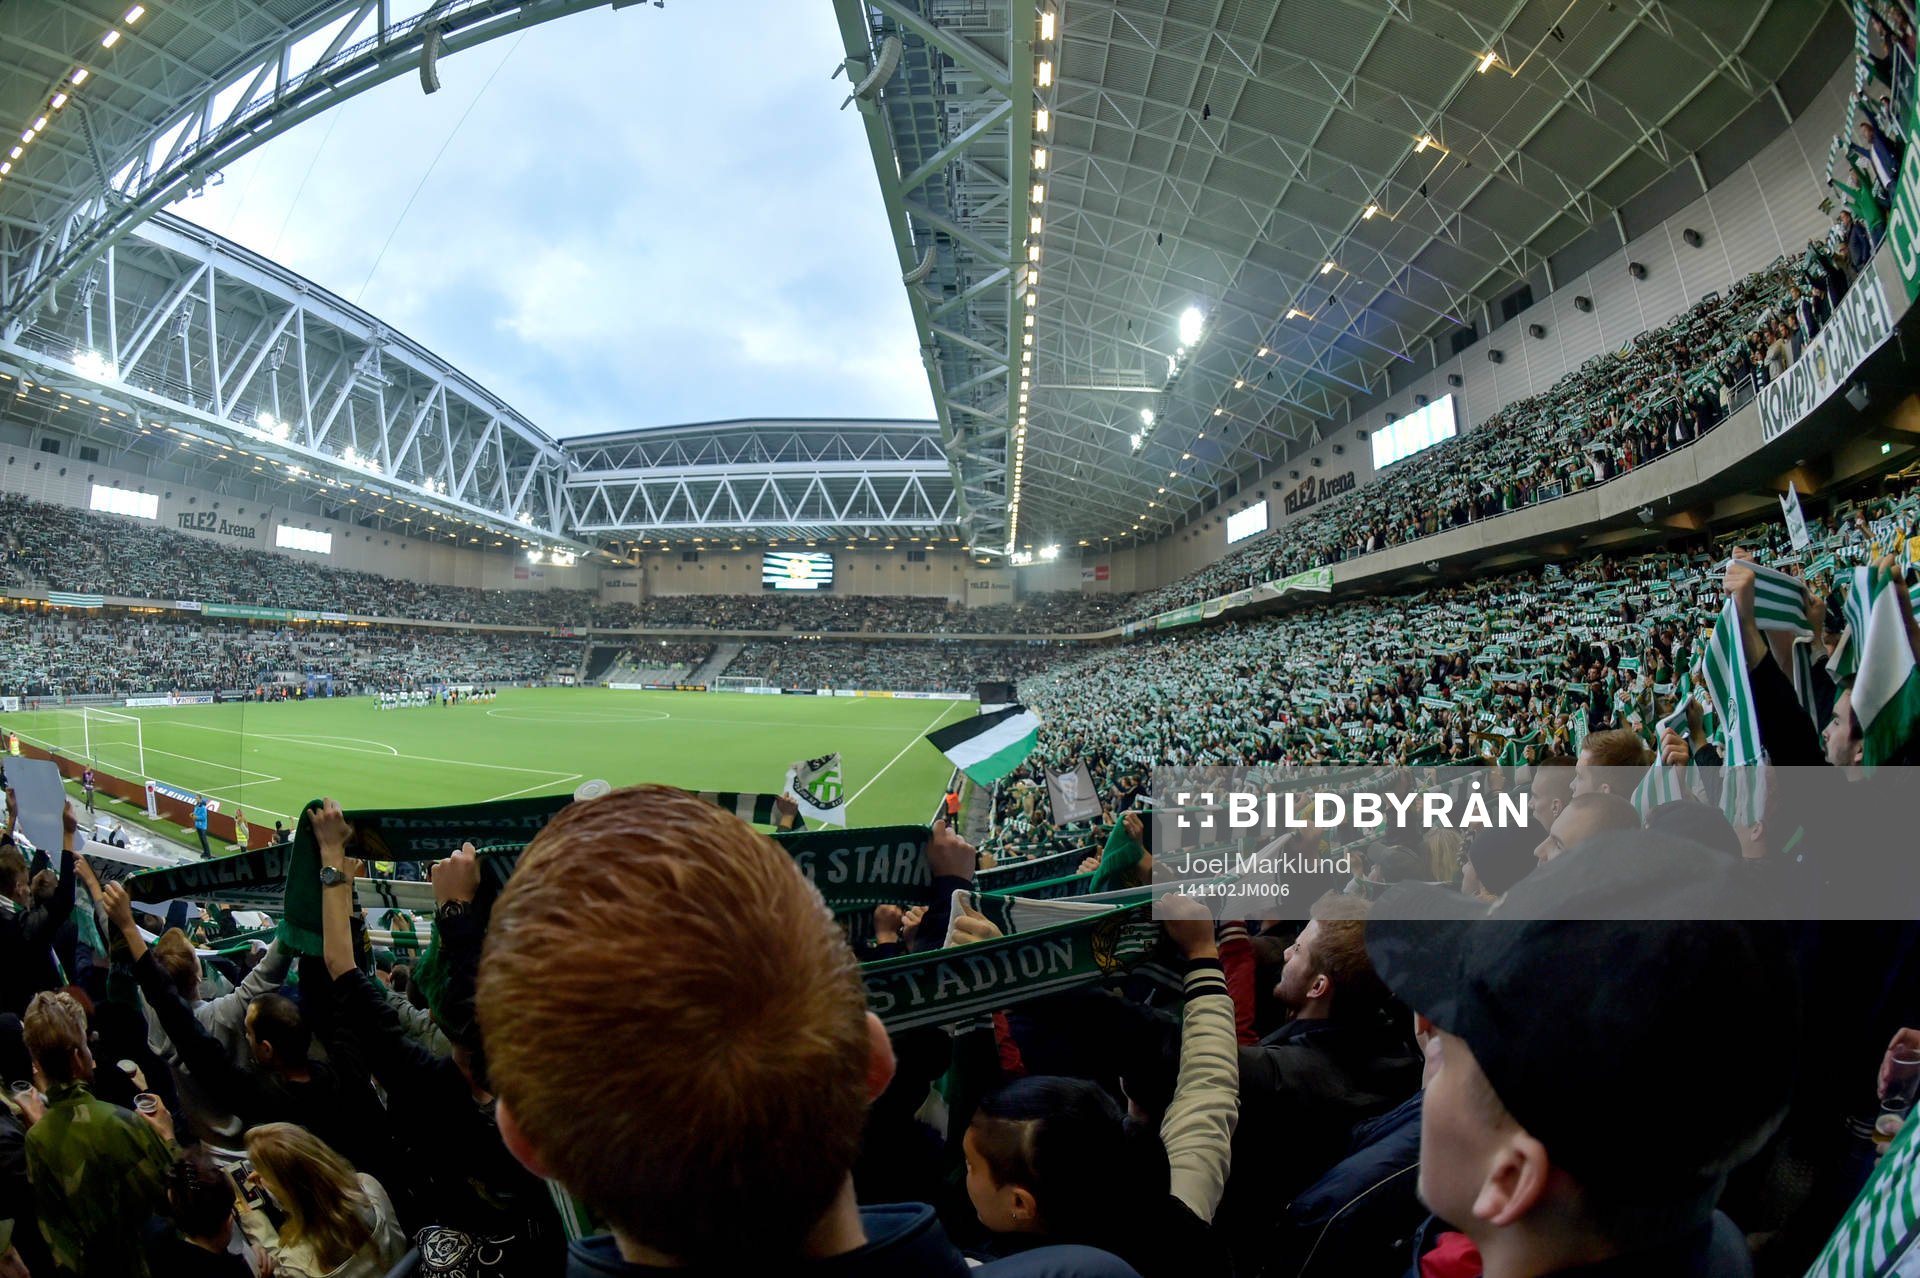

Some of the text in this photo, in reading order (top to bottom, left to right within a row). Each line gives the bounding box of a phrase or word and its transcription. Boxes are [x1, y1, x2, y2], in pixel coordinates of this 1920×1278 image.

[1758, 350, 1817, 440] KOMPIS
[1284, 471, 1356, 516] TELE2 Arena
[177, 511, 256, 538] TELE2 Arena
[864, 938, 1073, 1012] STADION
